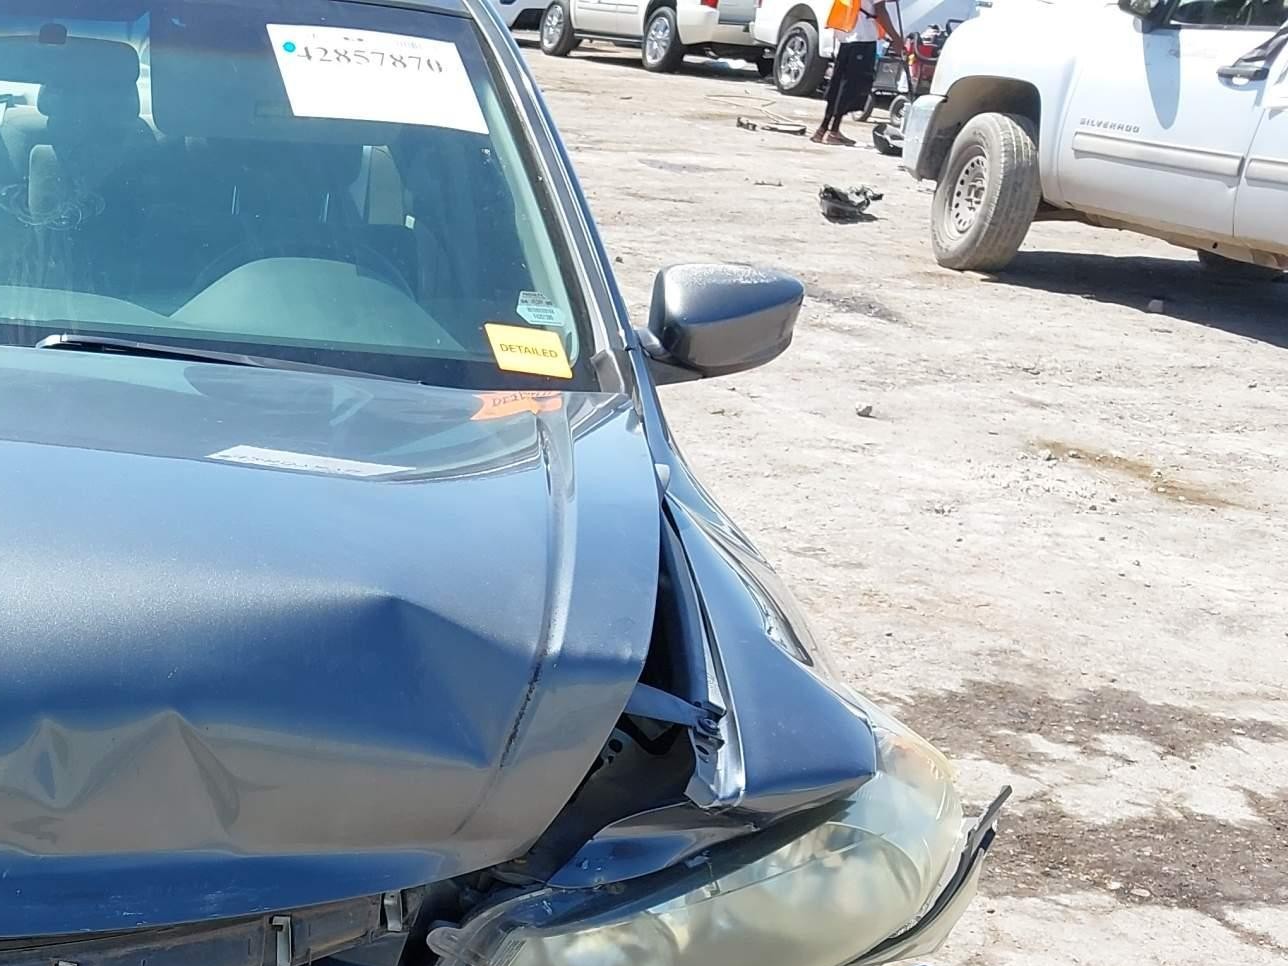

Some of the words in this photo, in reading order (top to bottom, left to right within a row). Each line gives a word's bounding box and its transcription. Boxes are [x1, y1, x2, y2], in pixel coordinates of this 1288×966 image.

[297, 46, 443, 72] 42857870
[1080, 119, 1140, 132] SILVERADO
[499, 343, 558, 358] DETAILED
